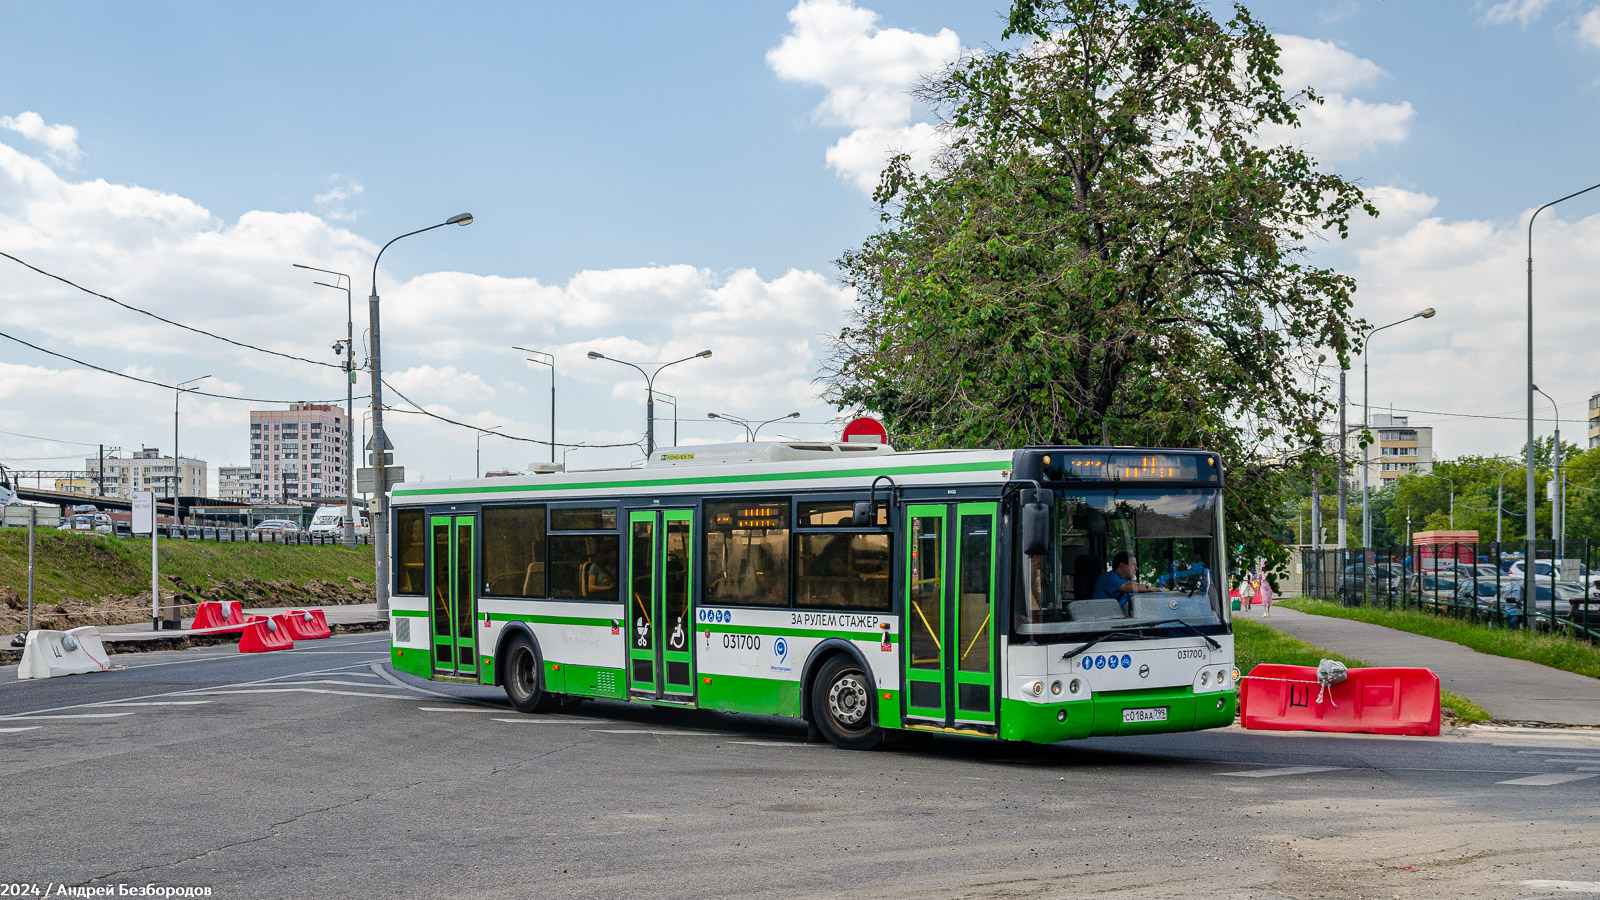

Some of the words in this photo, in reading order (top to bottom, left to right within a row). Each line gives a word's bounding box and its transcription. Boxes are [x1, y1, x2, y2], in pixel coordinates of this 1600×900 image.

[791, 613, 804, 625] ЗА
[804, 614, 836, 627] РУЛЕМ
[838, 615, 879, 628] СТАЖЕР
[723, 634, 761, 650] 031700
[1177, 649, 1203, 660] 031700
